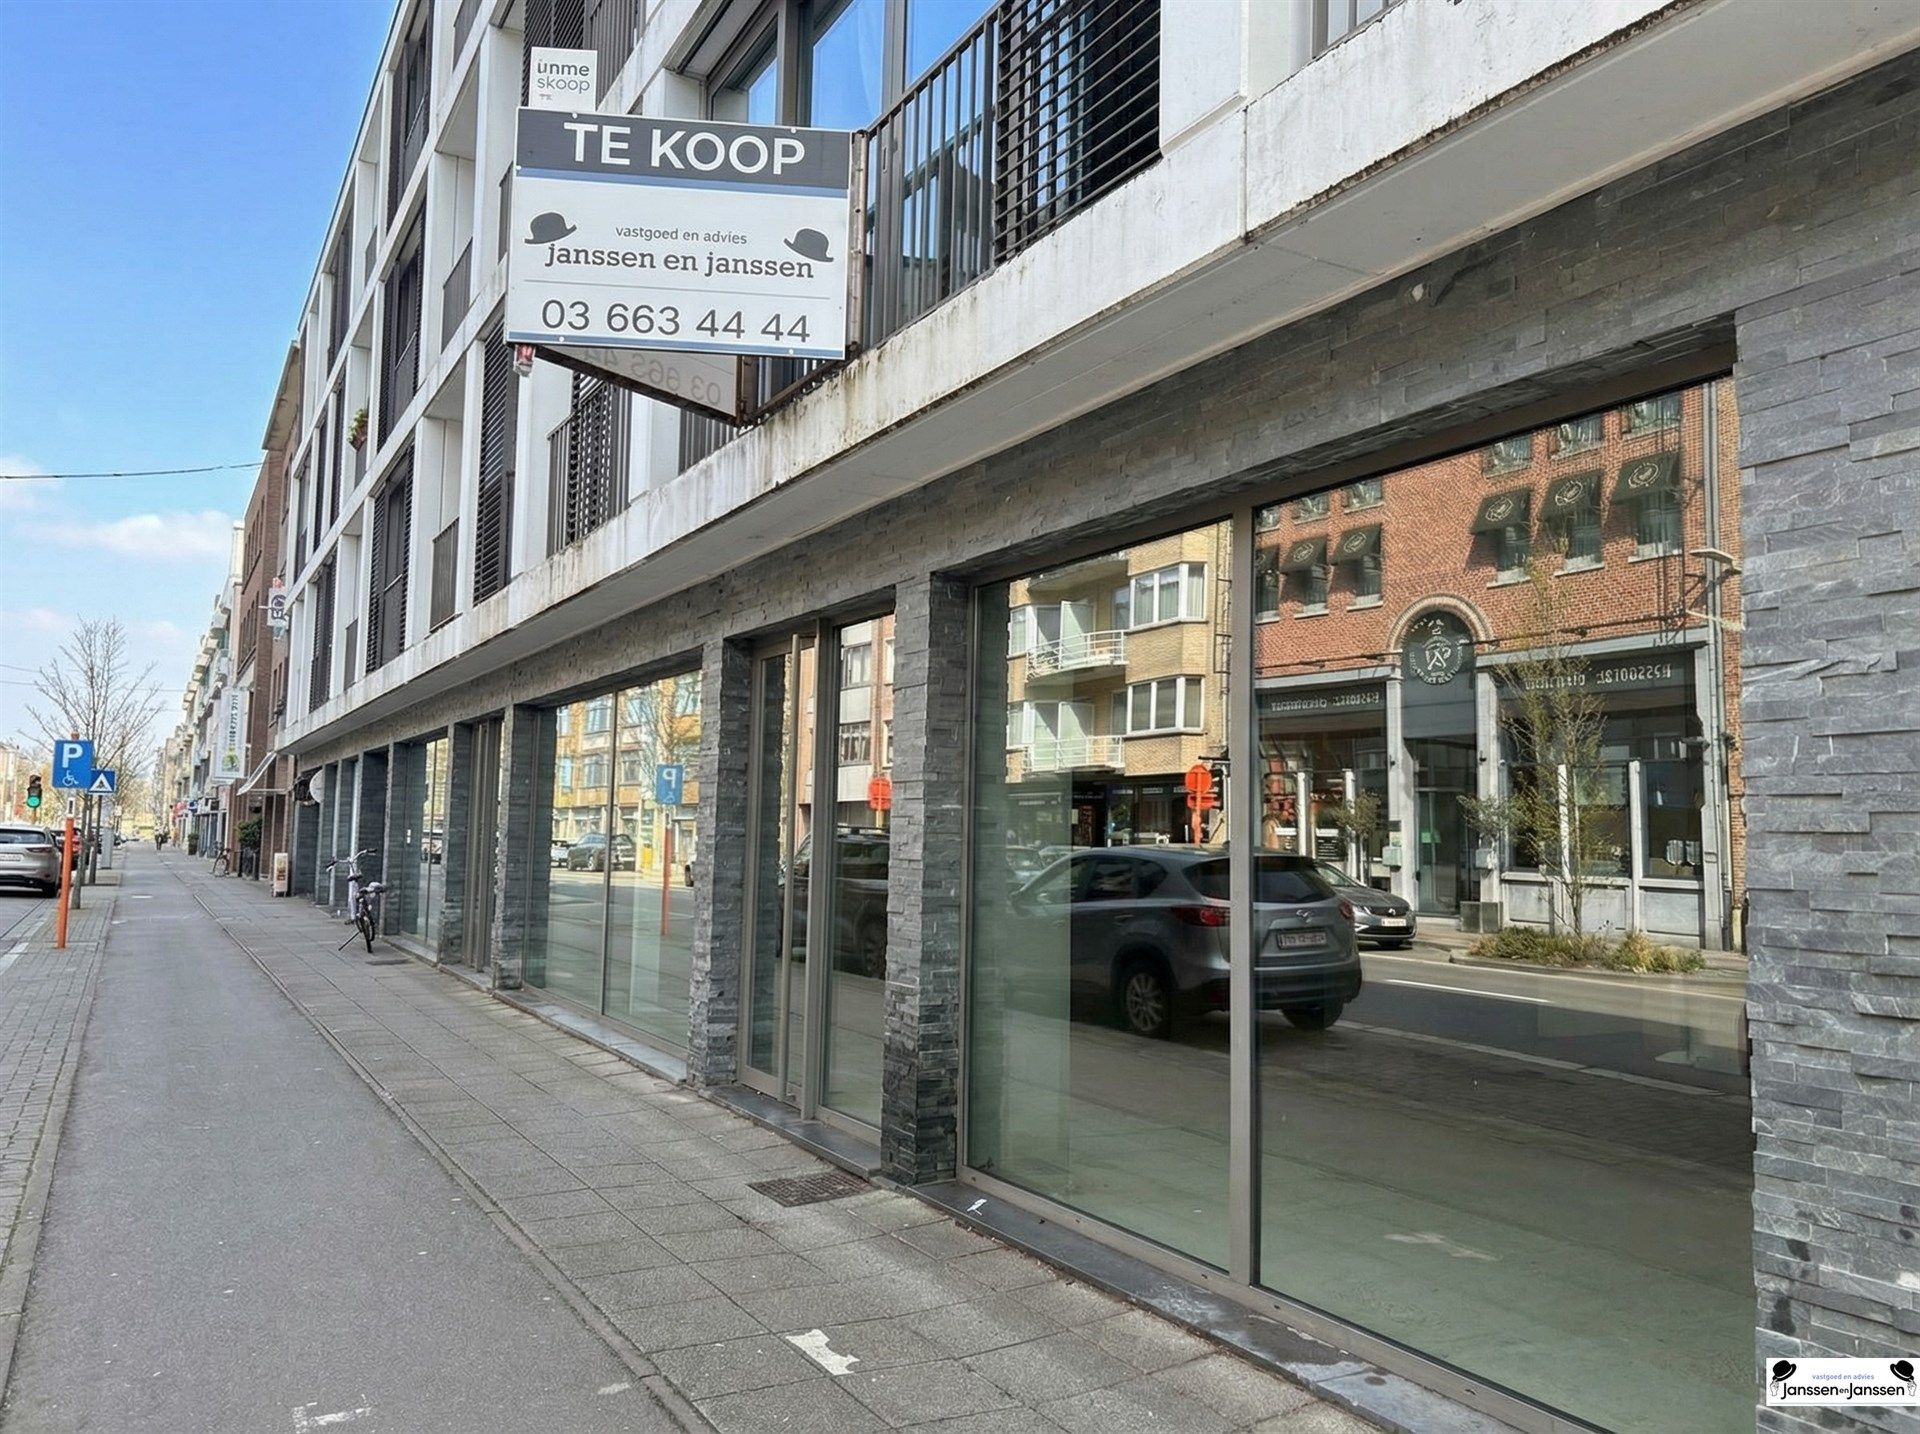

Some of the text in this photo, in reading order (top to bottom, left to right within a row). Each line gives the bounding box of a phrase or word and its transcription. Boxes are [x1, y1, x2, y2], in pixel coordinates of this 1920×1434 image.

[537, 75, 590, 94] skoop
[563, 122, 805, 175] TE KOOP
[615, 225, 748, 244] vastgoed en advies
[545, 242, 815, 279] janssen en janssen
[541, 299, 811, 344] 03 663 44 44
[62, 743, 83, 768] P
